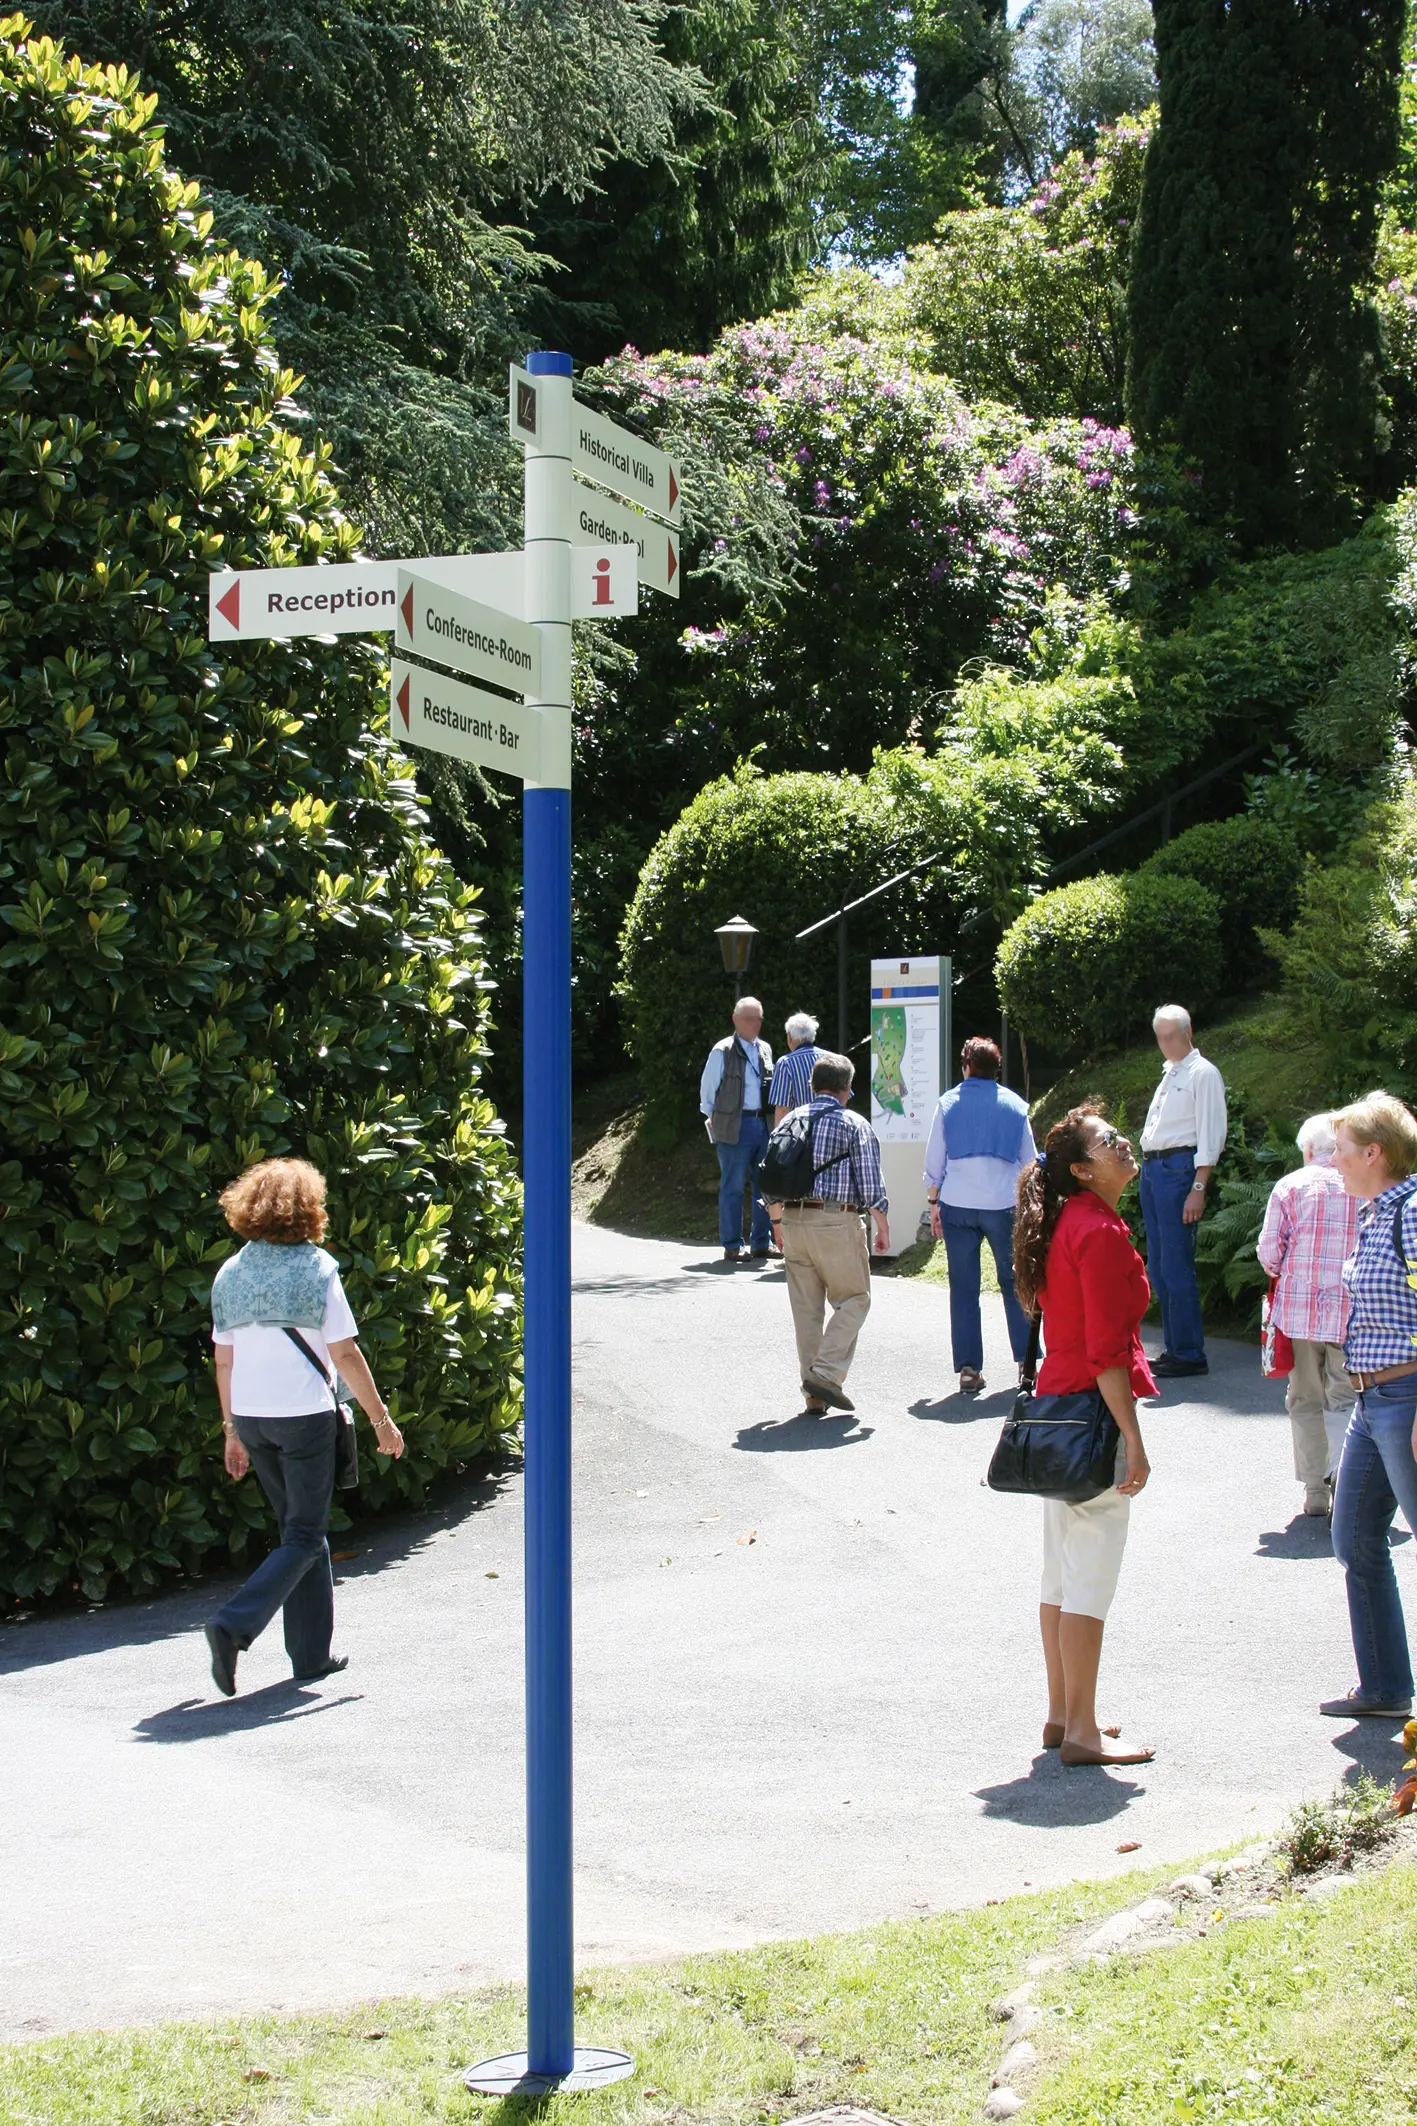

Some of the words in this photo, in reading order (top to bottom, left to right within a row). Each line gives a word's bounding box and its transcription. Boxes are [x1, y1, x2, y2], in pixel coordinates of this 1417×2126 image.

[580, 429, 630, 475] Historical
[632, 459, 654, 488] Villa
[580, 510, 617, 545] Garden
[267, 586, 396, 614] Reception
[426, 608, 532, 671] Conference-Room
[423, 696, 493, 741] Restaurant
[500, 724, 520, 750] Bar
